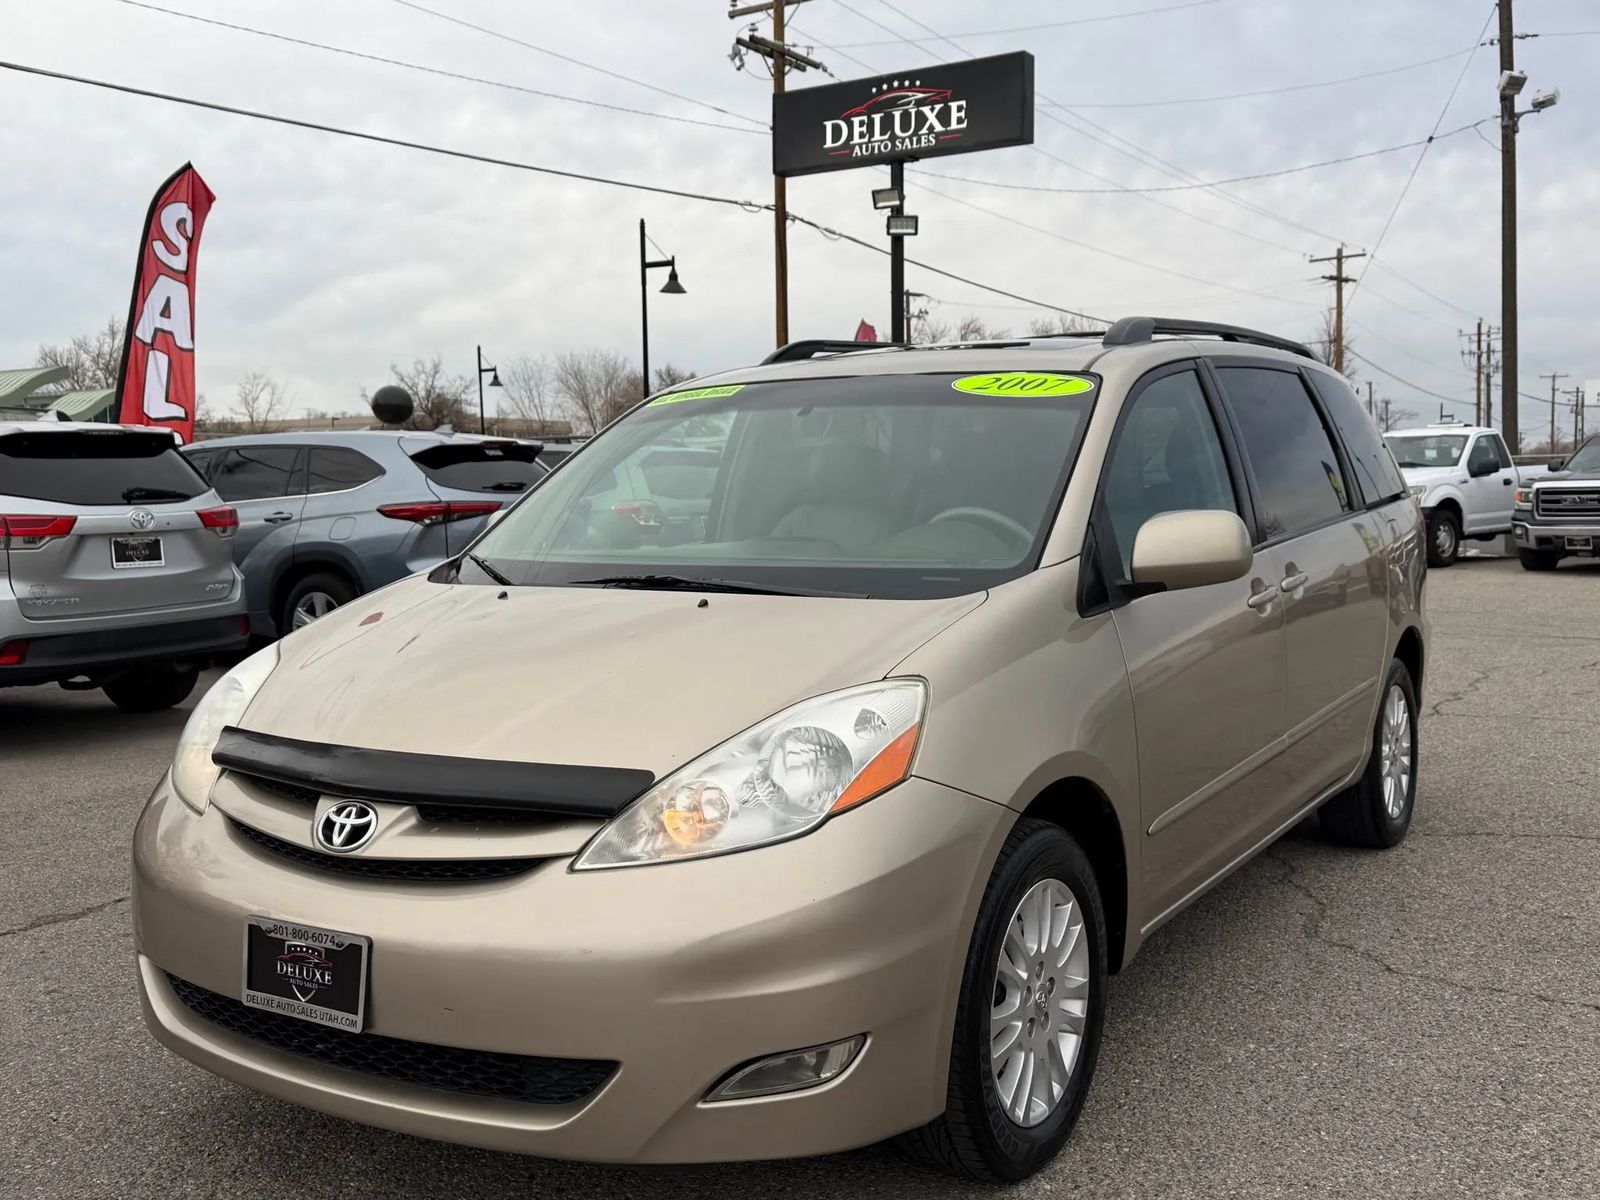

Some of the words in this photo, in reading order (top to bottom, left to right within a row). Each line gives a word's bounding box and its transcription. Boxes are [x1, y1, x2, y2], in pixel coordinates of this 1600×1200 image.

[823, 99, 968, 148] DELUXE
[852, 140, 892, 157] AUTO
[895, 133, 936, 151] SALES
[134, 200, 195, 445] SAL
[971, 377, 1072, 391] 2007
[273, 924, 335, 945] 801-800-6074
[277, 960, 333, 985] DELUXE
[290, 978, 303, 986] AUTO
[304, 981, 318, 989] SALES
[246, 993, 275, 1009] DELUXE
[276, 1001, 296, 1013] AUTO
[297, 1005, 318, 1019] SALES
[319, 1010, 358, 1030] UTAH.COM
